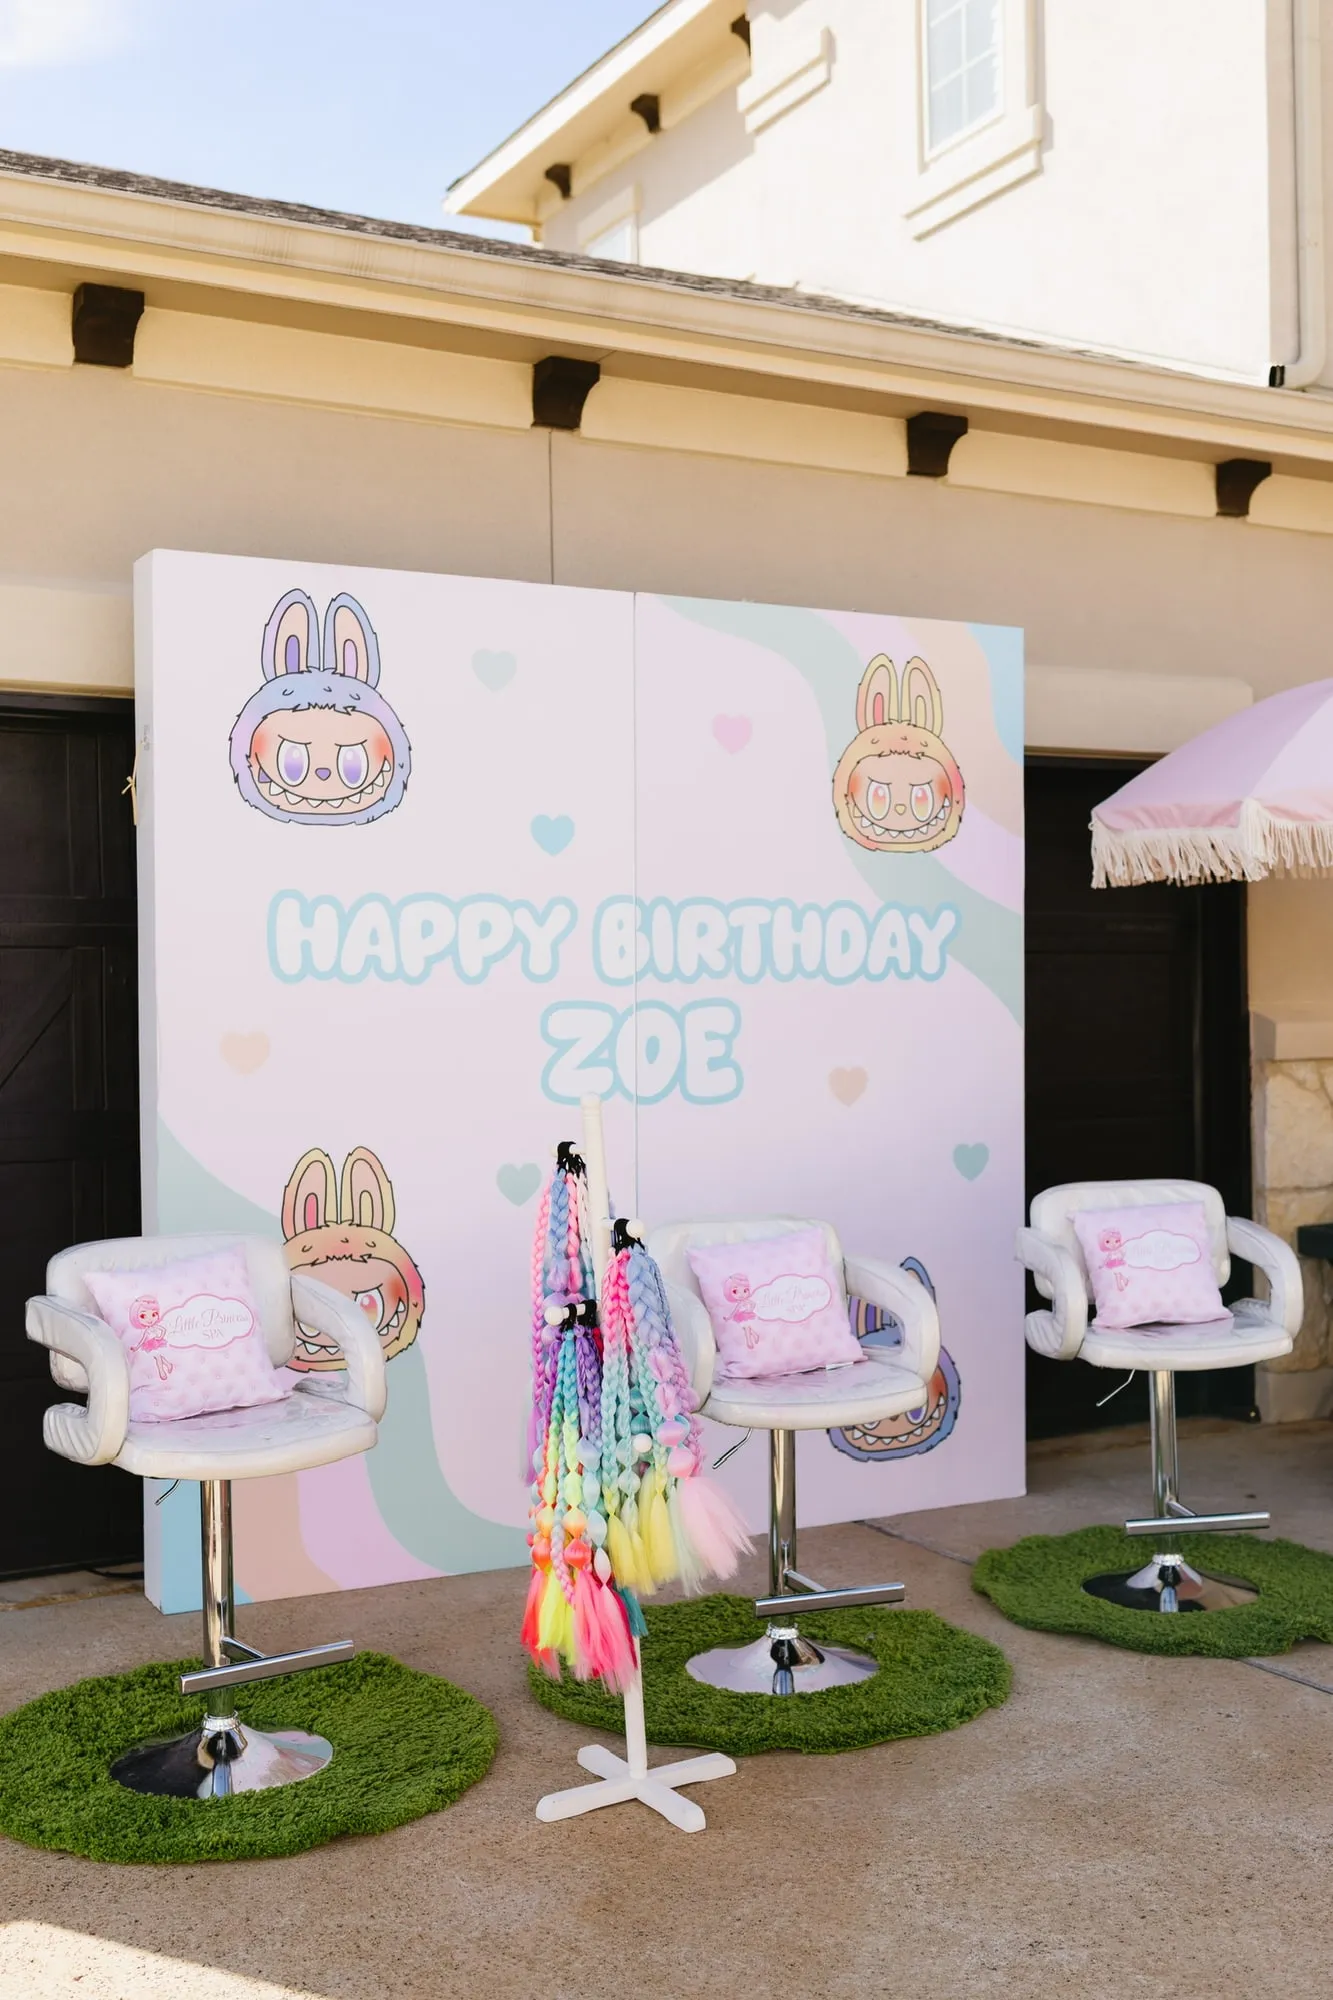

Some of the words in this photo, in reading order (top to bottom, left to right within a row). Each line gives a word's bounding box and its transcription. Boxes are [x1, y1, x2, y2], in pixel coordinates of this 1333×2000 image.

[268, 890, 577, 983] HAPPY
[593, 895, 961, 985] BIRTHDAY
[541, 998, 743, 1105] ZOE
[169, 1315, 199, 1335] Little
[202, 1329, 224, 1340] SPA
